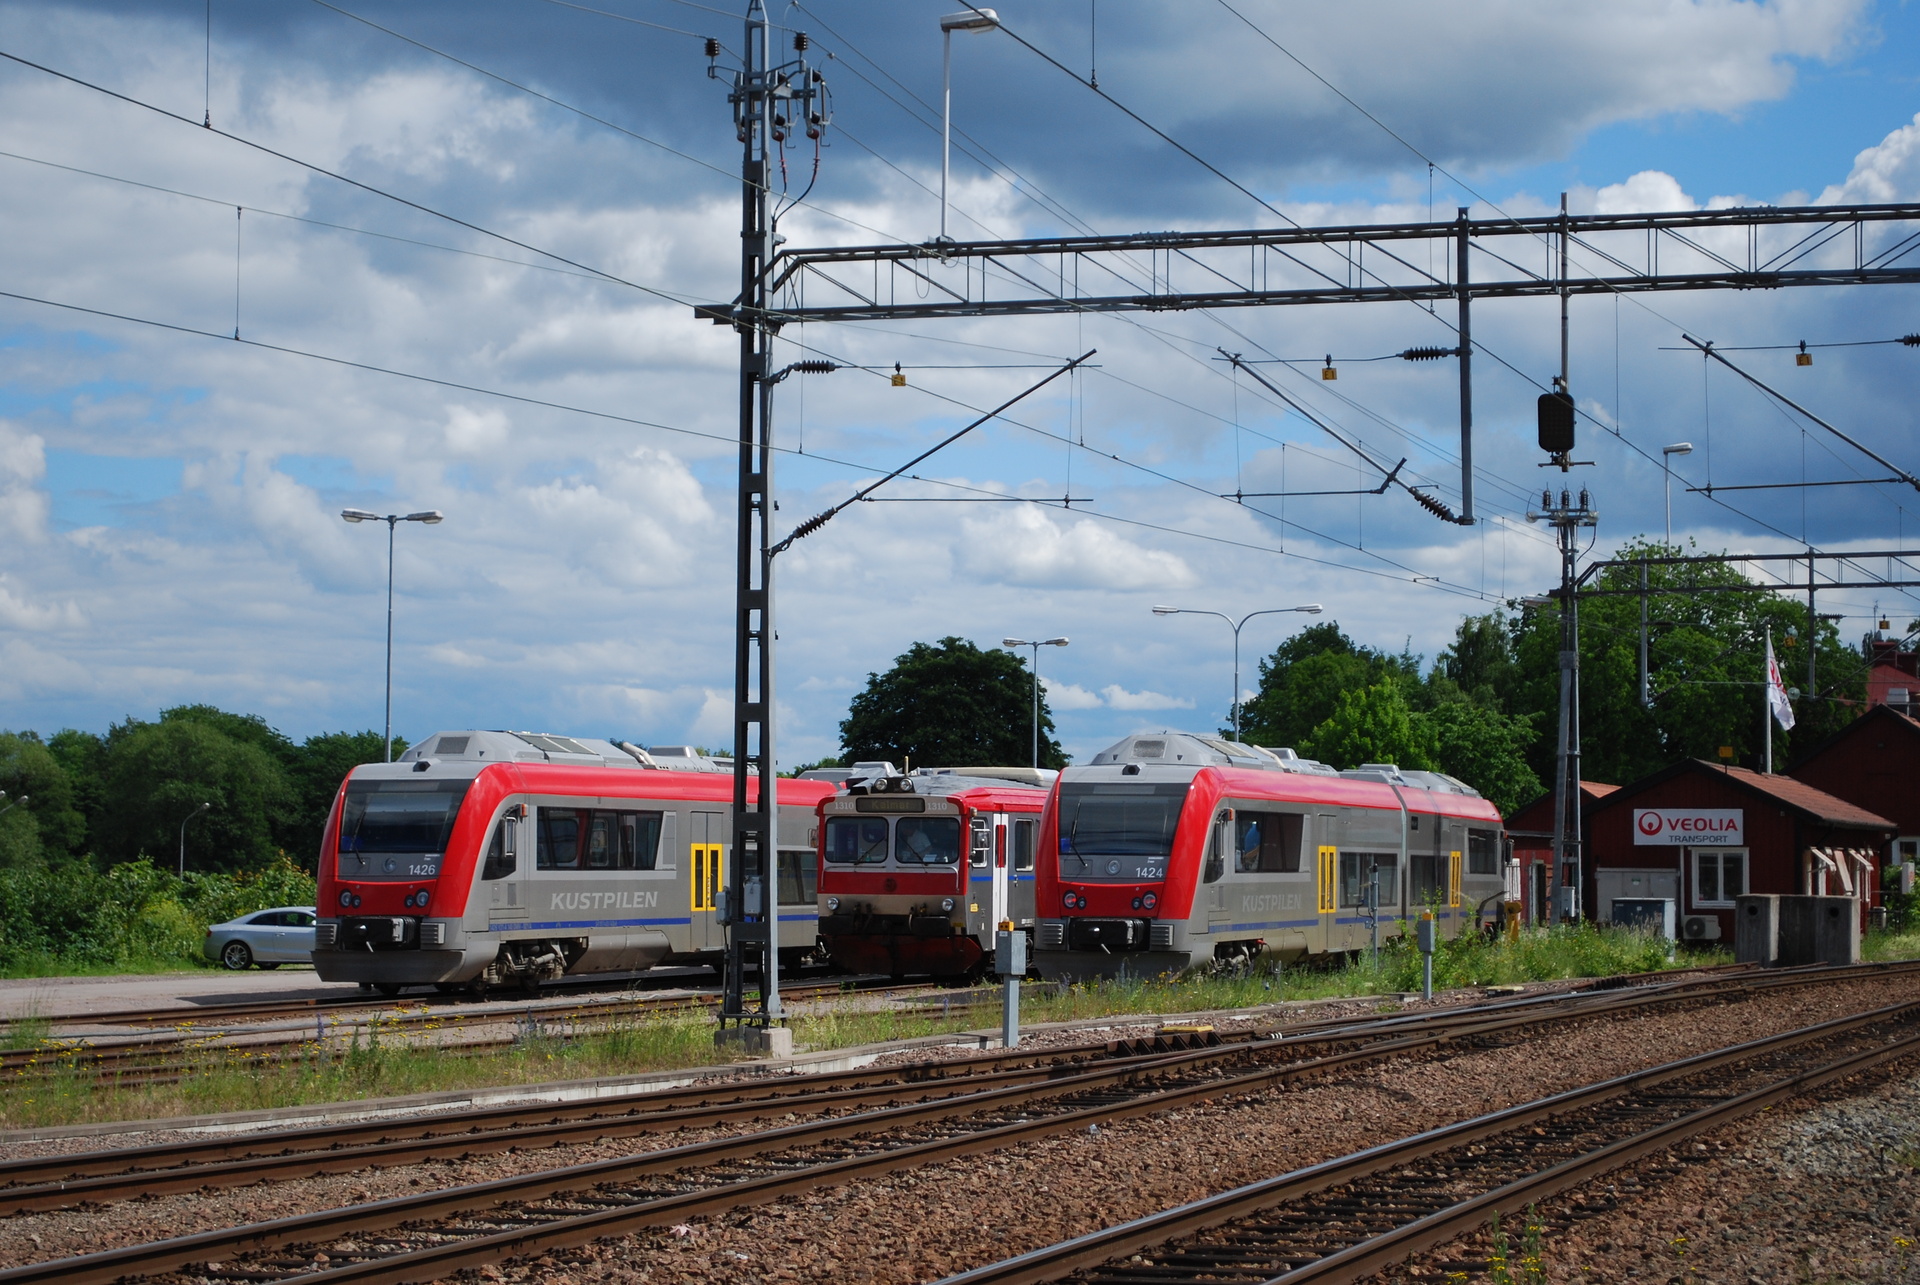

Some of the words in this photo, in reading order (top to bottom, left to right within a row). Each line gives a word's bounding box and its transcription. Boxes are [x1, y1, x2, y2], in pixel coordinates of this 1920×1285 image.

[1325, 370, 1335, 380] E1
[834, 801, 854, 810] 1310
[927, 802, 948, 811] 1310
[1667, 818, 1738, 831] VEOLIA
[1668, 835, 1729, 843] TRANSPORT
[409, 864, 436, 875] 1426
[1136, 867, 1163, 878] 1424
[550, 891, 658, 910] KUSTPILEN
[1242, 894, 1302, 912] KUSTPILEN
